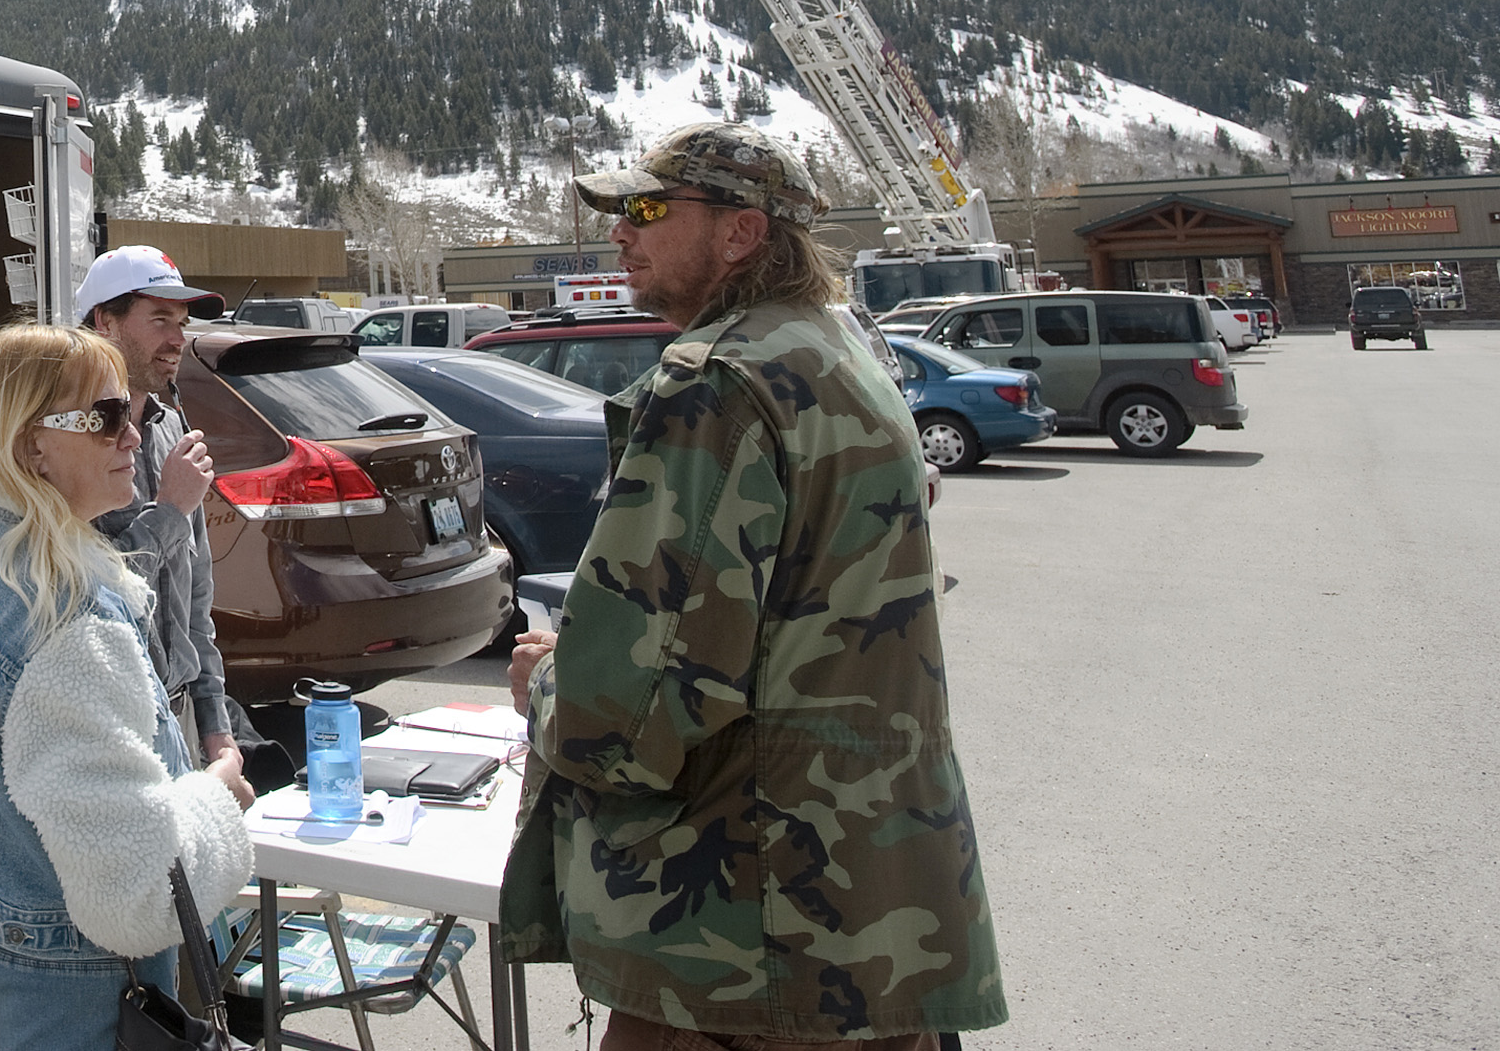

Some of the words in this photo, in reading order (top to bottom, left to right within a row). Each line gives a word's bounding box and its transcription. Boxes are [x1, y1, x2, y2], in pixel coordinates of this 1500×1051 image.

[887, 51, 932, 120] JACKSON
[932, 120, 958, 162] HOLE
[1333, 212, 1395, 223] JACKSON
[1401, 210, 1453, 220] MOORE
[1360, 222, 1427, 232] LIGHTING
[533, 255, 598, 272] SEARS
